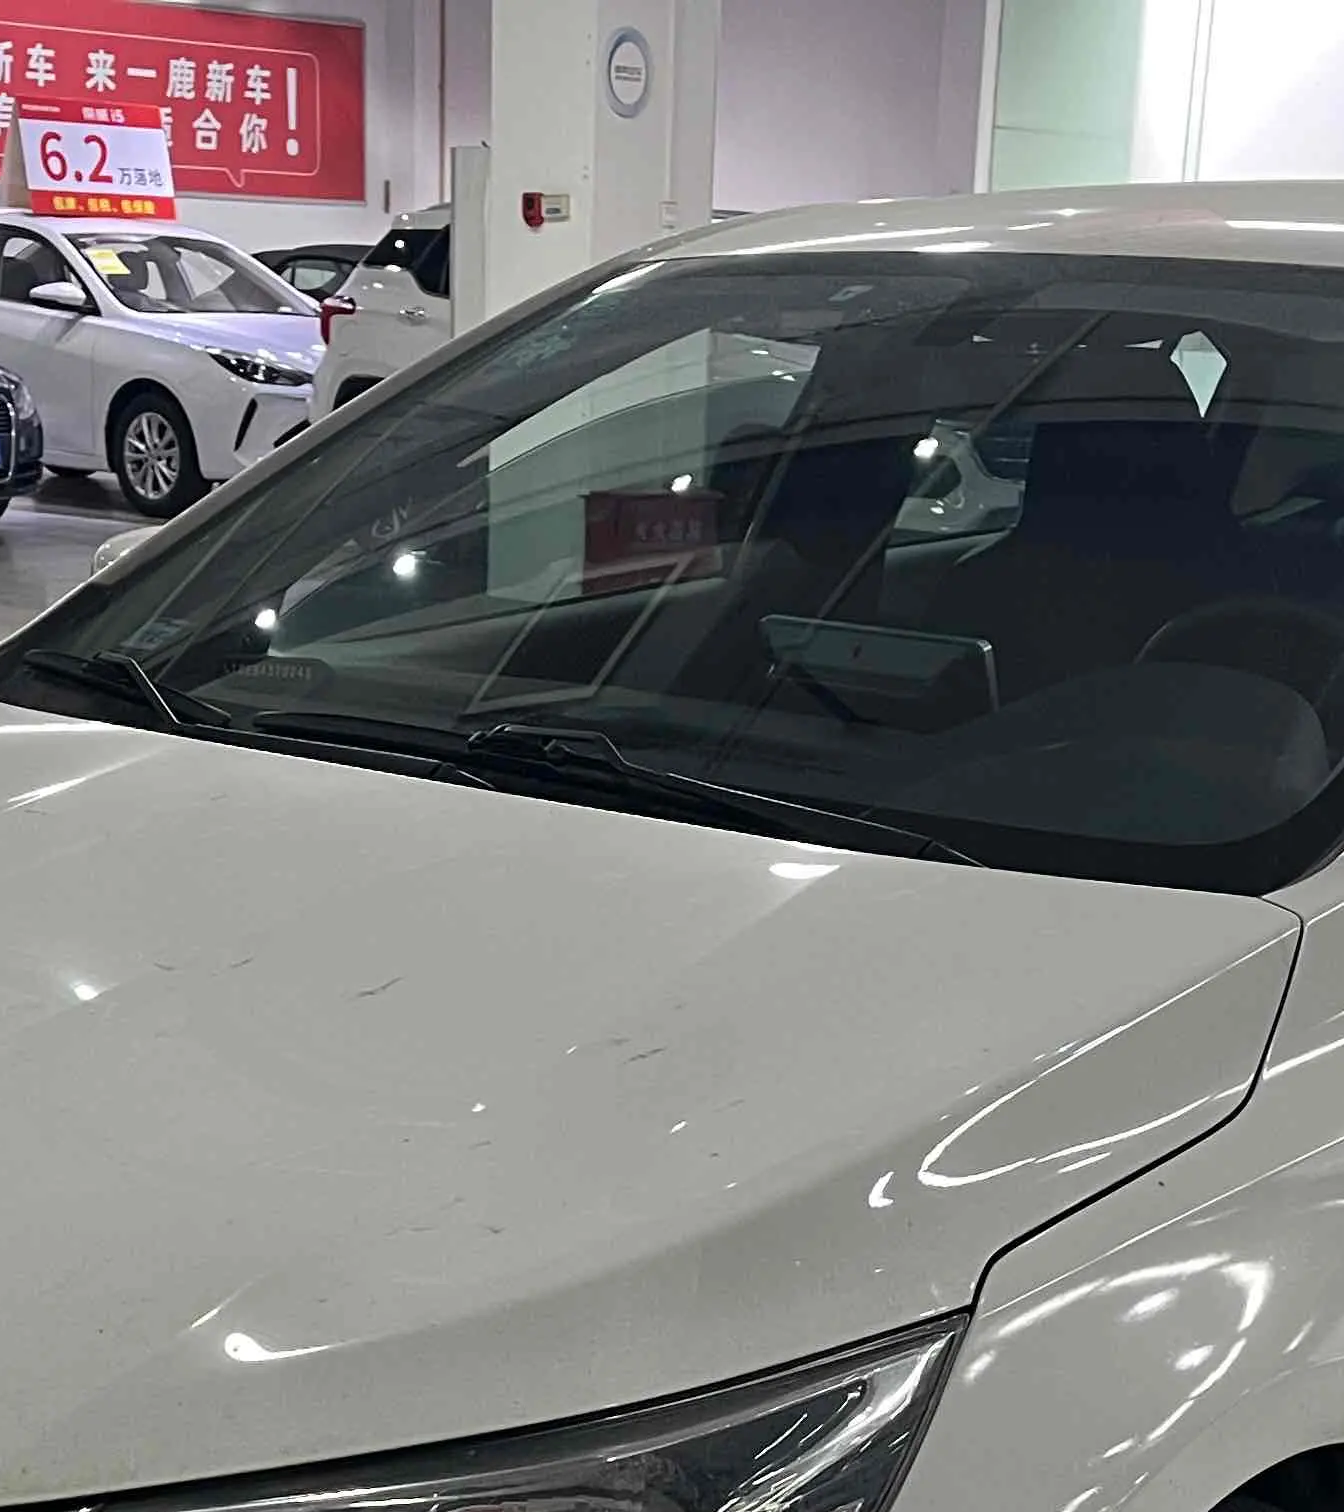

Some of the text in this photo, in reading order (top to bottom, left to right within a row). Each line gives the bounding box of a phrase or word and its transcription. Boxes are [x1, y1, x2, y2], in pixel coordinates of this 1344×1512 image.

[86, 49, 272, 105] 来一鹿新车
[40, 131, 114, 184] 6.2
